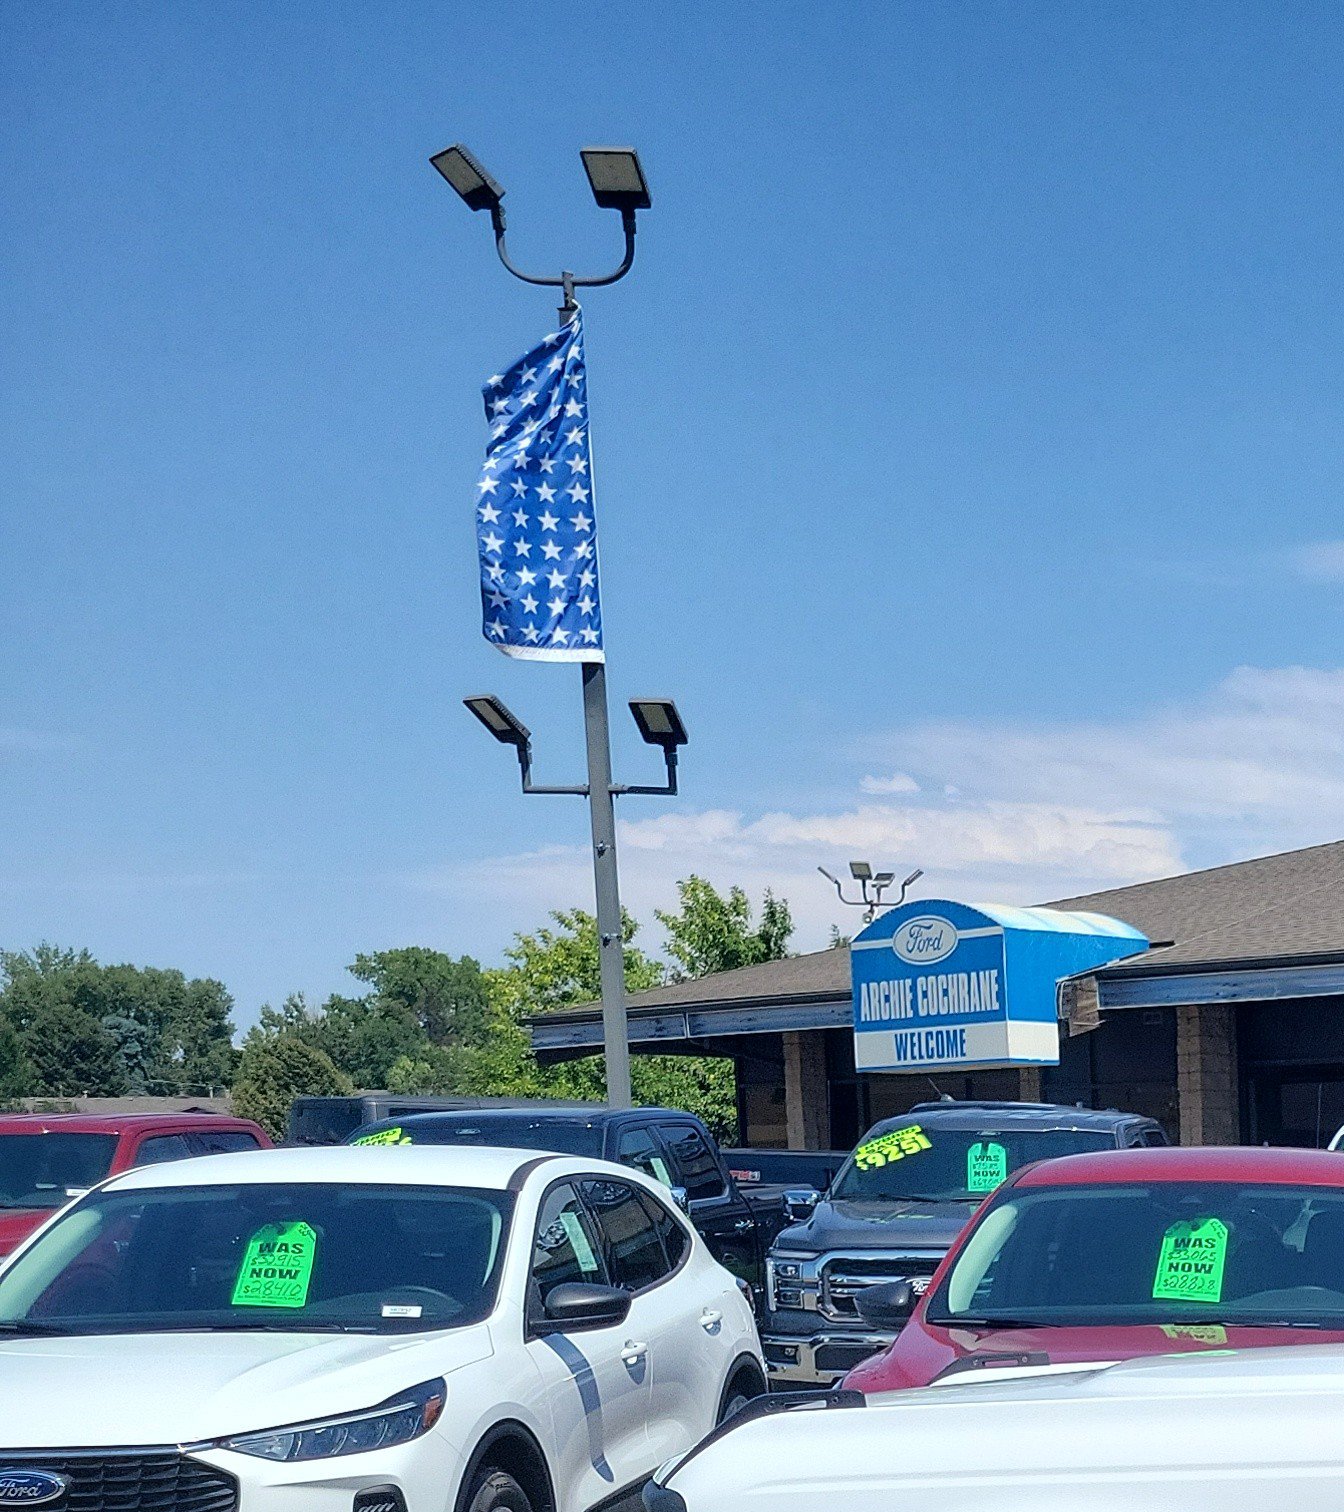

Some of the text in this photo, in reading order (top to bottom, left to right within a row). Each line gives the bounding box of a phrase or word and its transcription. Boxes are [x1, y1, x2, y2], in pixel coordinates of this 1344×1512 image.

[904, 923, 944, 954] Ford
[860, 968, 1000, 1022] ARCHIE COCHRANE
[894, 1028, 967, 1062] WELCOME
[974, 1169, 1001, 1178] NOW
[258, 1242, 305, 1255] WAS
[1173, 1237, 1217, 1249] WAS
[249, 1267, 302, 1280] NOW
[1167, 1261, 1214, 1274] NOW
[0, 1478, 42, 1498] Ford
